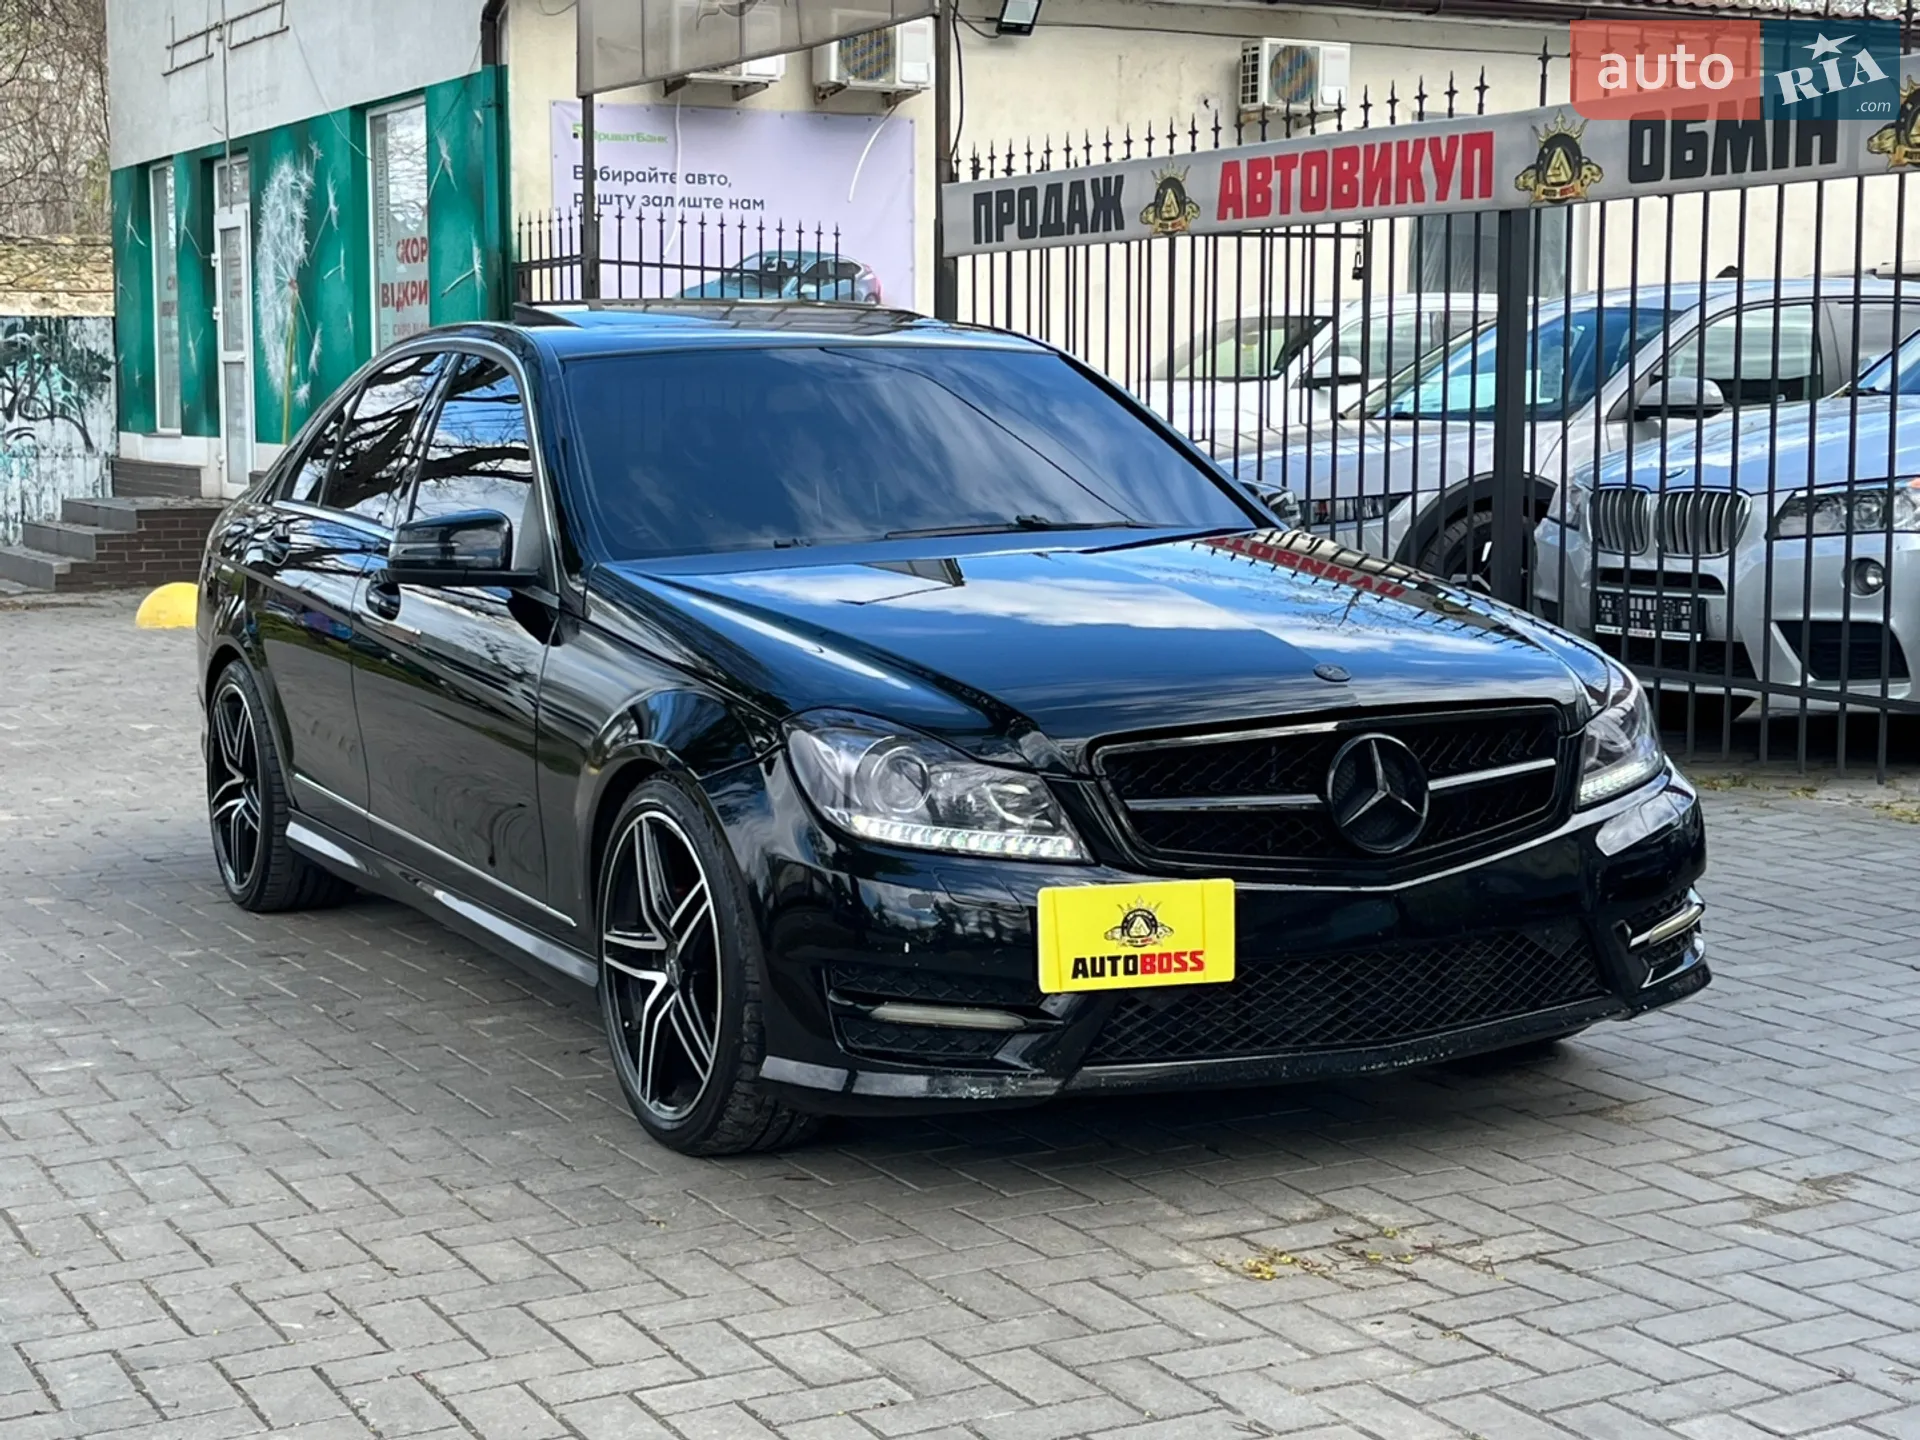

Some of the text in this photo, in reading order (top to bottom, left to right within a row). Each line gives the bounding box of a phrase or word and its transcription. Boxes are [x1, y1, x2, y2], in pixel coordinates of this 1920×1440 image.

[1628, 92, 1838, 184] ОБМІН
[573, 164, 732, 189] Вбирайте авто,
[573, 192, 637, 210] ршту
[729, 198, 765, 211] нам
[1216, 130, 1494, 222] АВТОВИКУП
[972, 174, 1125, 246] ПРОДАЖ
[1072, 950, 1205, 980] AUTOBOSS
